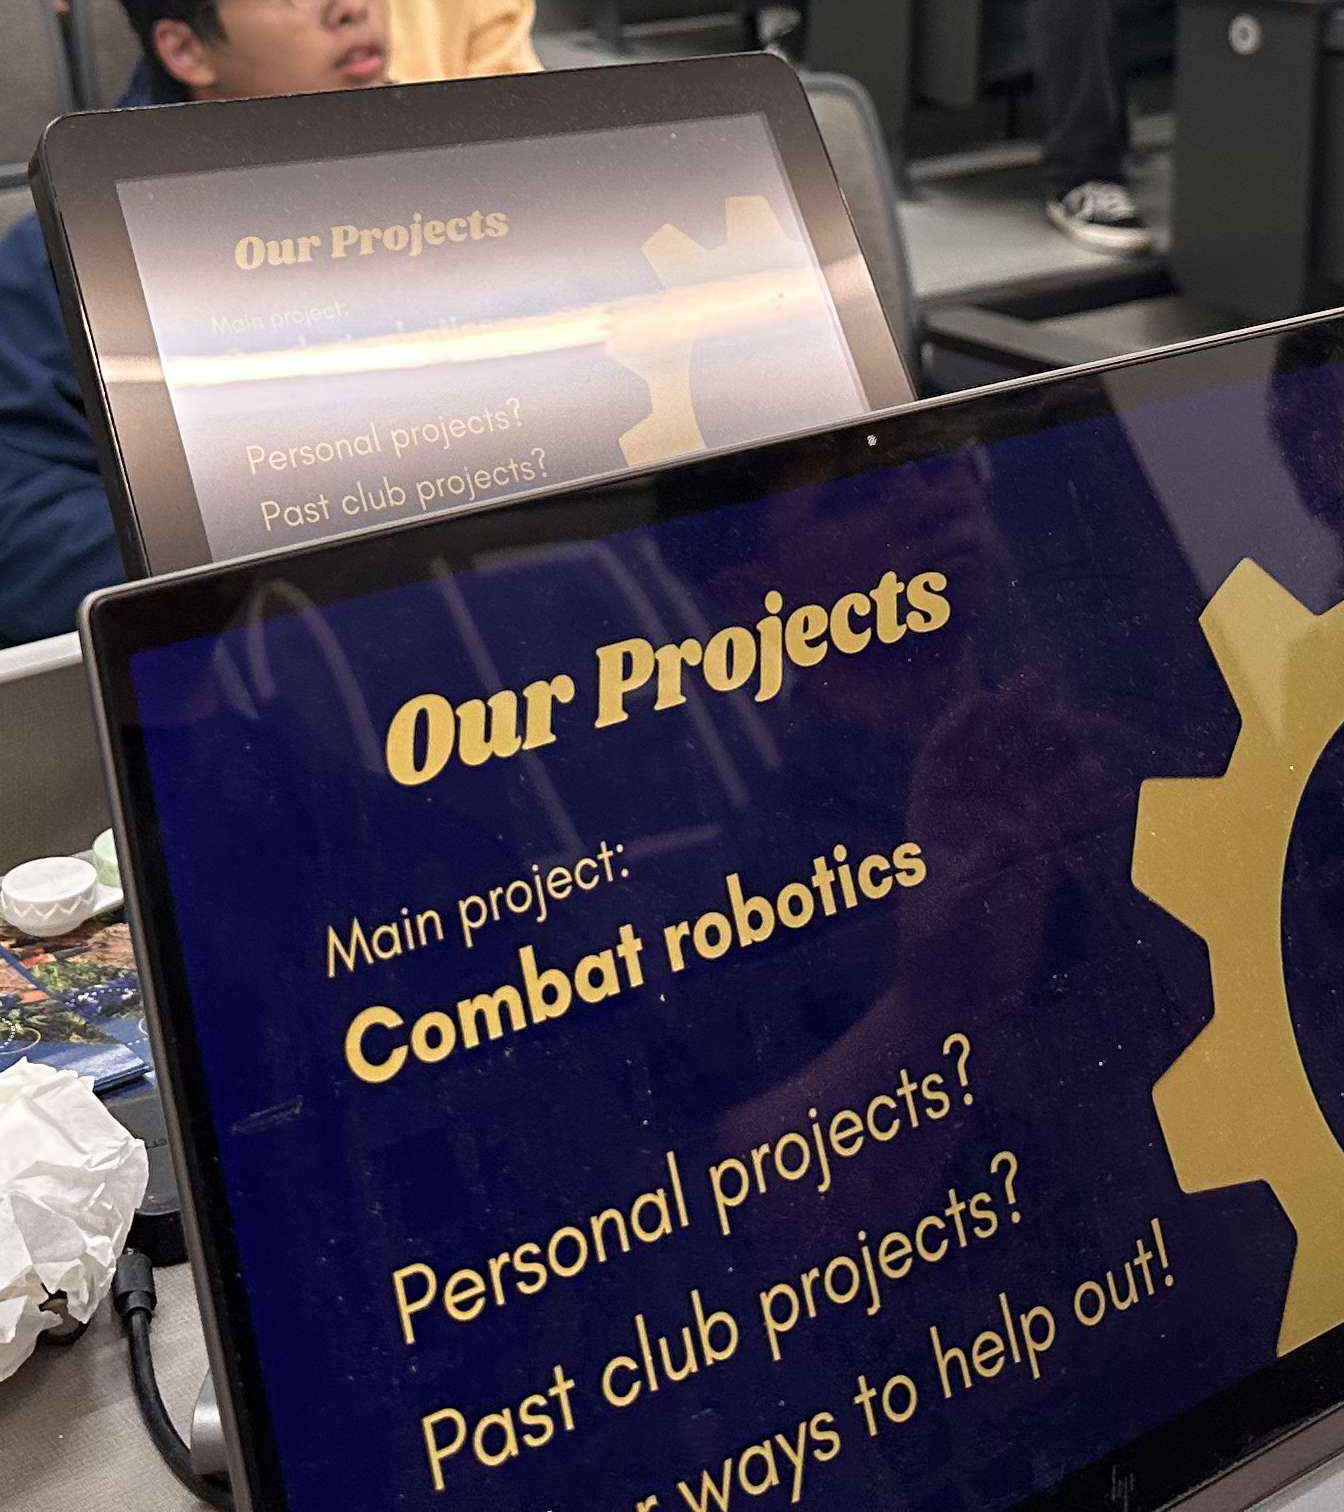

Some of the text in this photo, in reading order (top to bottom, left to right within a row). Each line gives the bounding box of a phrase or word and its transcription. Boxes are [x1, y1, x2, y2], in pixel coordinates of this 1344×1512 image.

[210, 314, 265, 336] Main
[271, 300, 350, 331] project:
[234, 209, 510, 270] Our Projects
[246, 397, 524, 476] Personal projects?
[260, 446, 548, 532] Past club projects?
[384, 568, 952, 786] Our Projects
[327, 838, 632, 977] Main project:
[343, 841, 928, 1085] Combat robotics
[393, 1033, 978, 1345] Personal projects?
[421, 1151, 1024, 1491] Past club projects?
[677, 1218, 1176, 1512] ways to help out!
